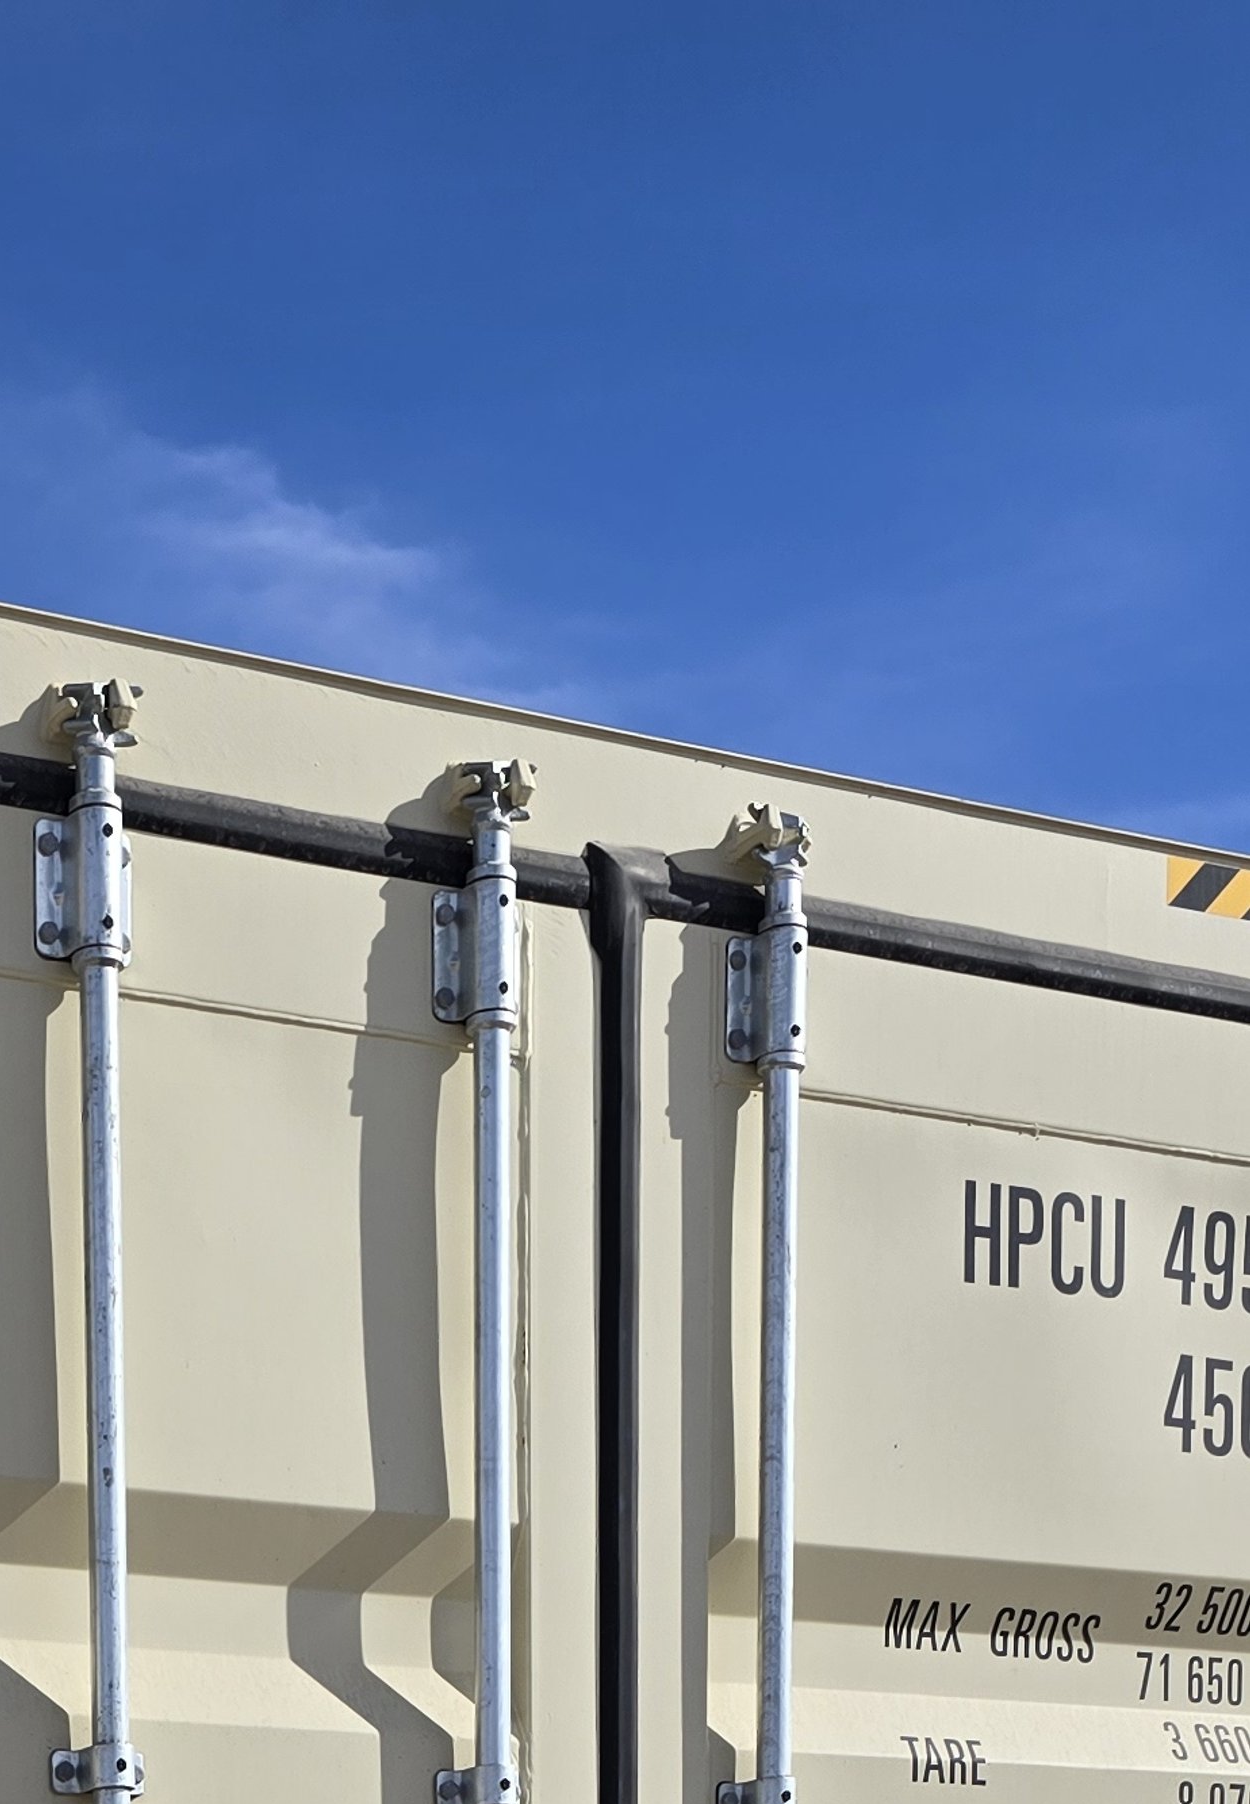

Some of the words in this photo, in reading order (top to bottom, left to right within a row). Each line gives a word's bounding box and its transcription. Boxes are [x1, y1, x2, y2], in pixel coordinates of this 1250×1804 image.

[963, 1179, 1126, 1299] HPCU
[1163, 1205, 1250, 1314] 49
[884, 1597, 971, 1653] MAX
[990, 1607, 1101, 1663] GROSS
[1145, 1582, 1192, 1632] 32
[1136, 1652, 1170, 1701] 71
[1187, 1655, 1243, 1706] 650
[900, 1735, 987, 1786] TARE
[1163, 1721, 1188, 1760] 3
[1194, 1723, 1250, 1764] 660
